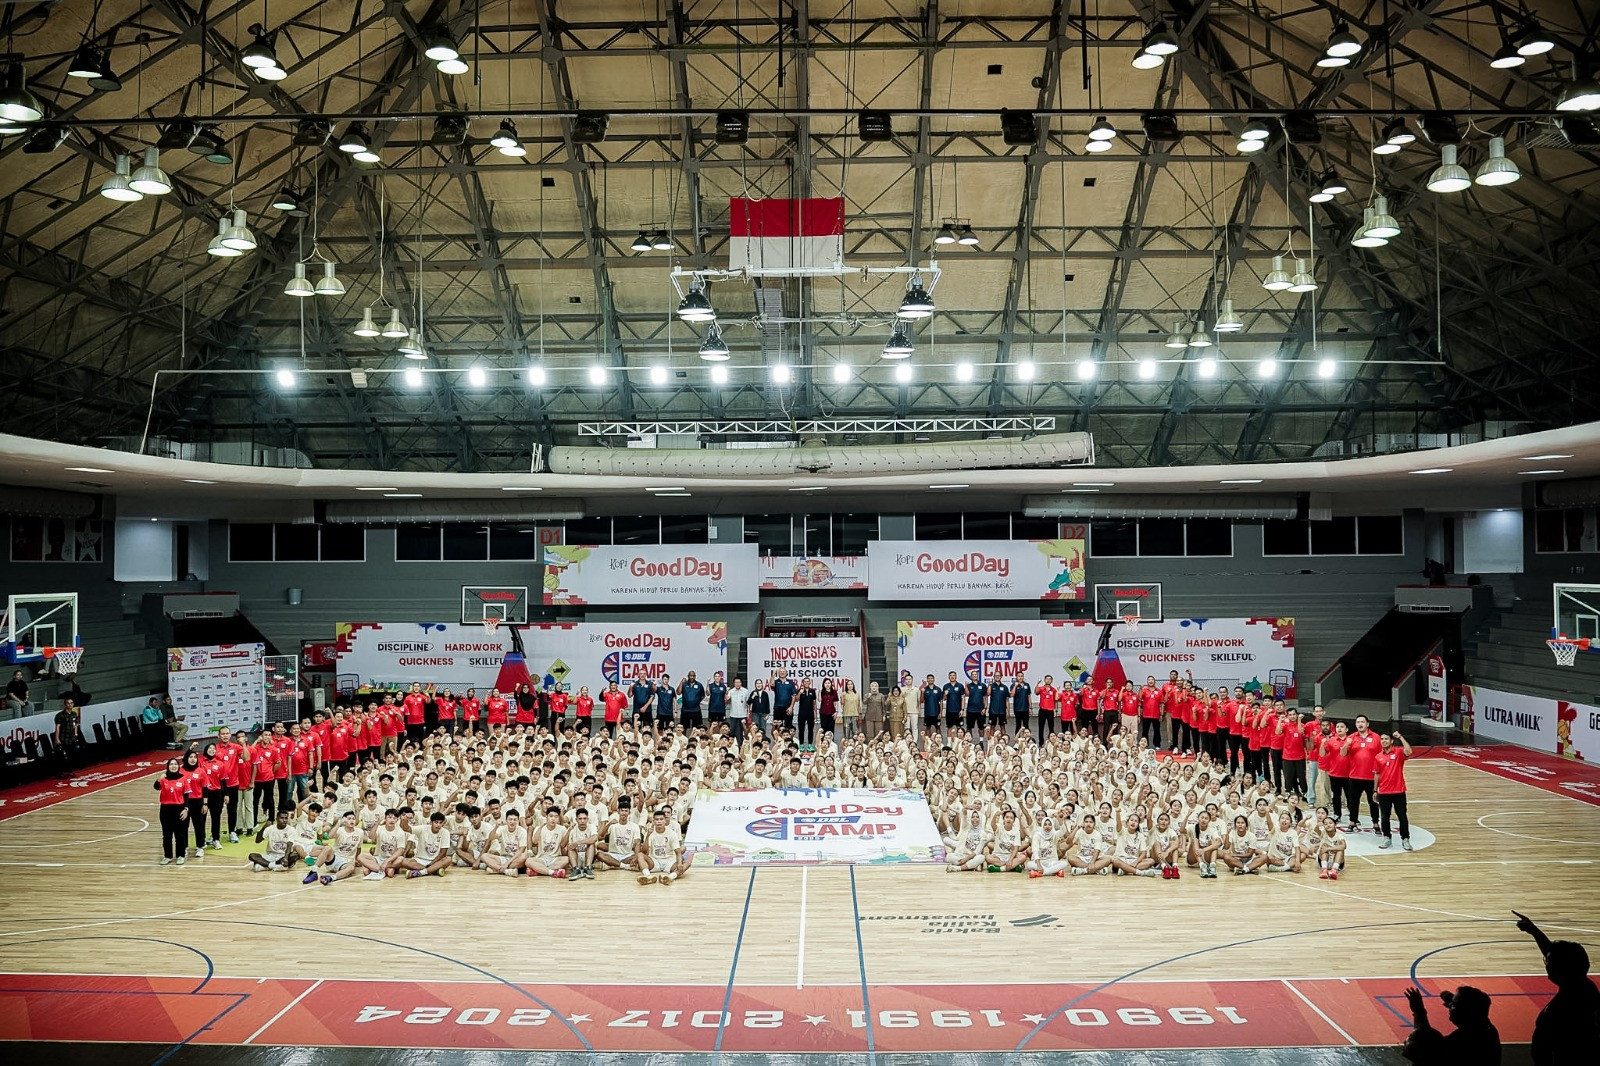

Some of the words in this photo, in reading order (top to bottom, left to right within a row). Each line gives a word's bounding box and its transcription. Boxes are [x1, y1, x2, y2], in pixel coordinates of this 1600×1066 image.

[540, 529, 561, 545] D1
[1063, 525, 1085, 539] D2
[377, 643, 429, 651] DISCIPLINE
[444, 643, 502, 651] HARDWORK
[1117, 639, 1170, 648] DISCIPLINE
[1186, 639, 1245, 647] HARDWORK
[770, 645, 837, 660] INDONESIA'S
[1139, 653, 1195, 662] QUICKNESS
[1210, 653, 1254, 662] SKILLFUL
[399, 657, 454, 666] QUICKNESS
[469, 657, 505, 666] SKILLFU
[764, 660, 787, 668] BEST
[790, 660, 798, 668] &
[800, 659, 843, 668] BIGGEST
[799, 669, 840, 678] SCHOOL
[1484, 705, 1513, 727] ULTRA
[1515, 712, 1541, 731] MILK
[794, 823, 897, 836] CAMP
[353, 1006, 552, 1026] 2024
[607, 1009, 784, 1028] 2017
[846, 1008, 1006, 1028] 1991
[1066, 1005, 1248, 1027] 1990
